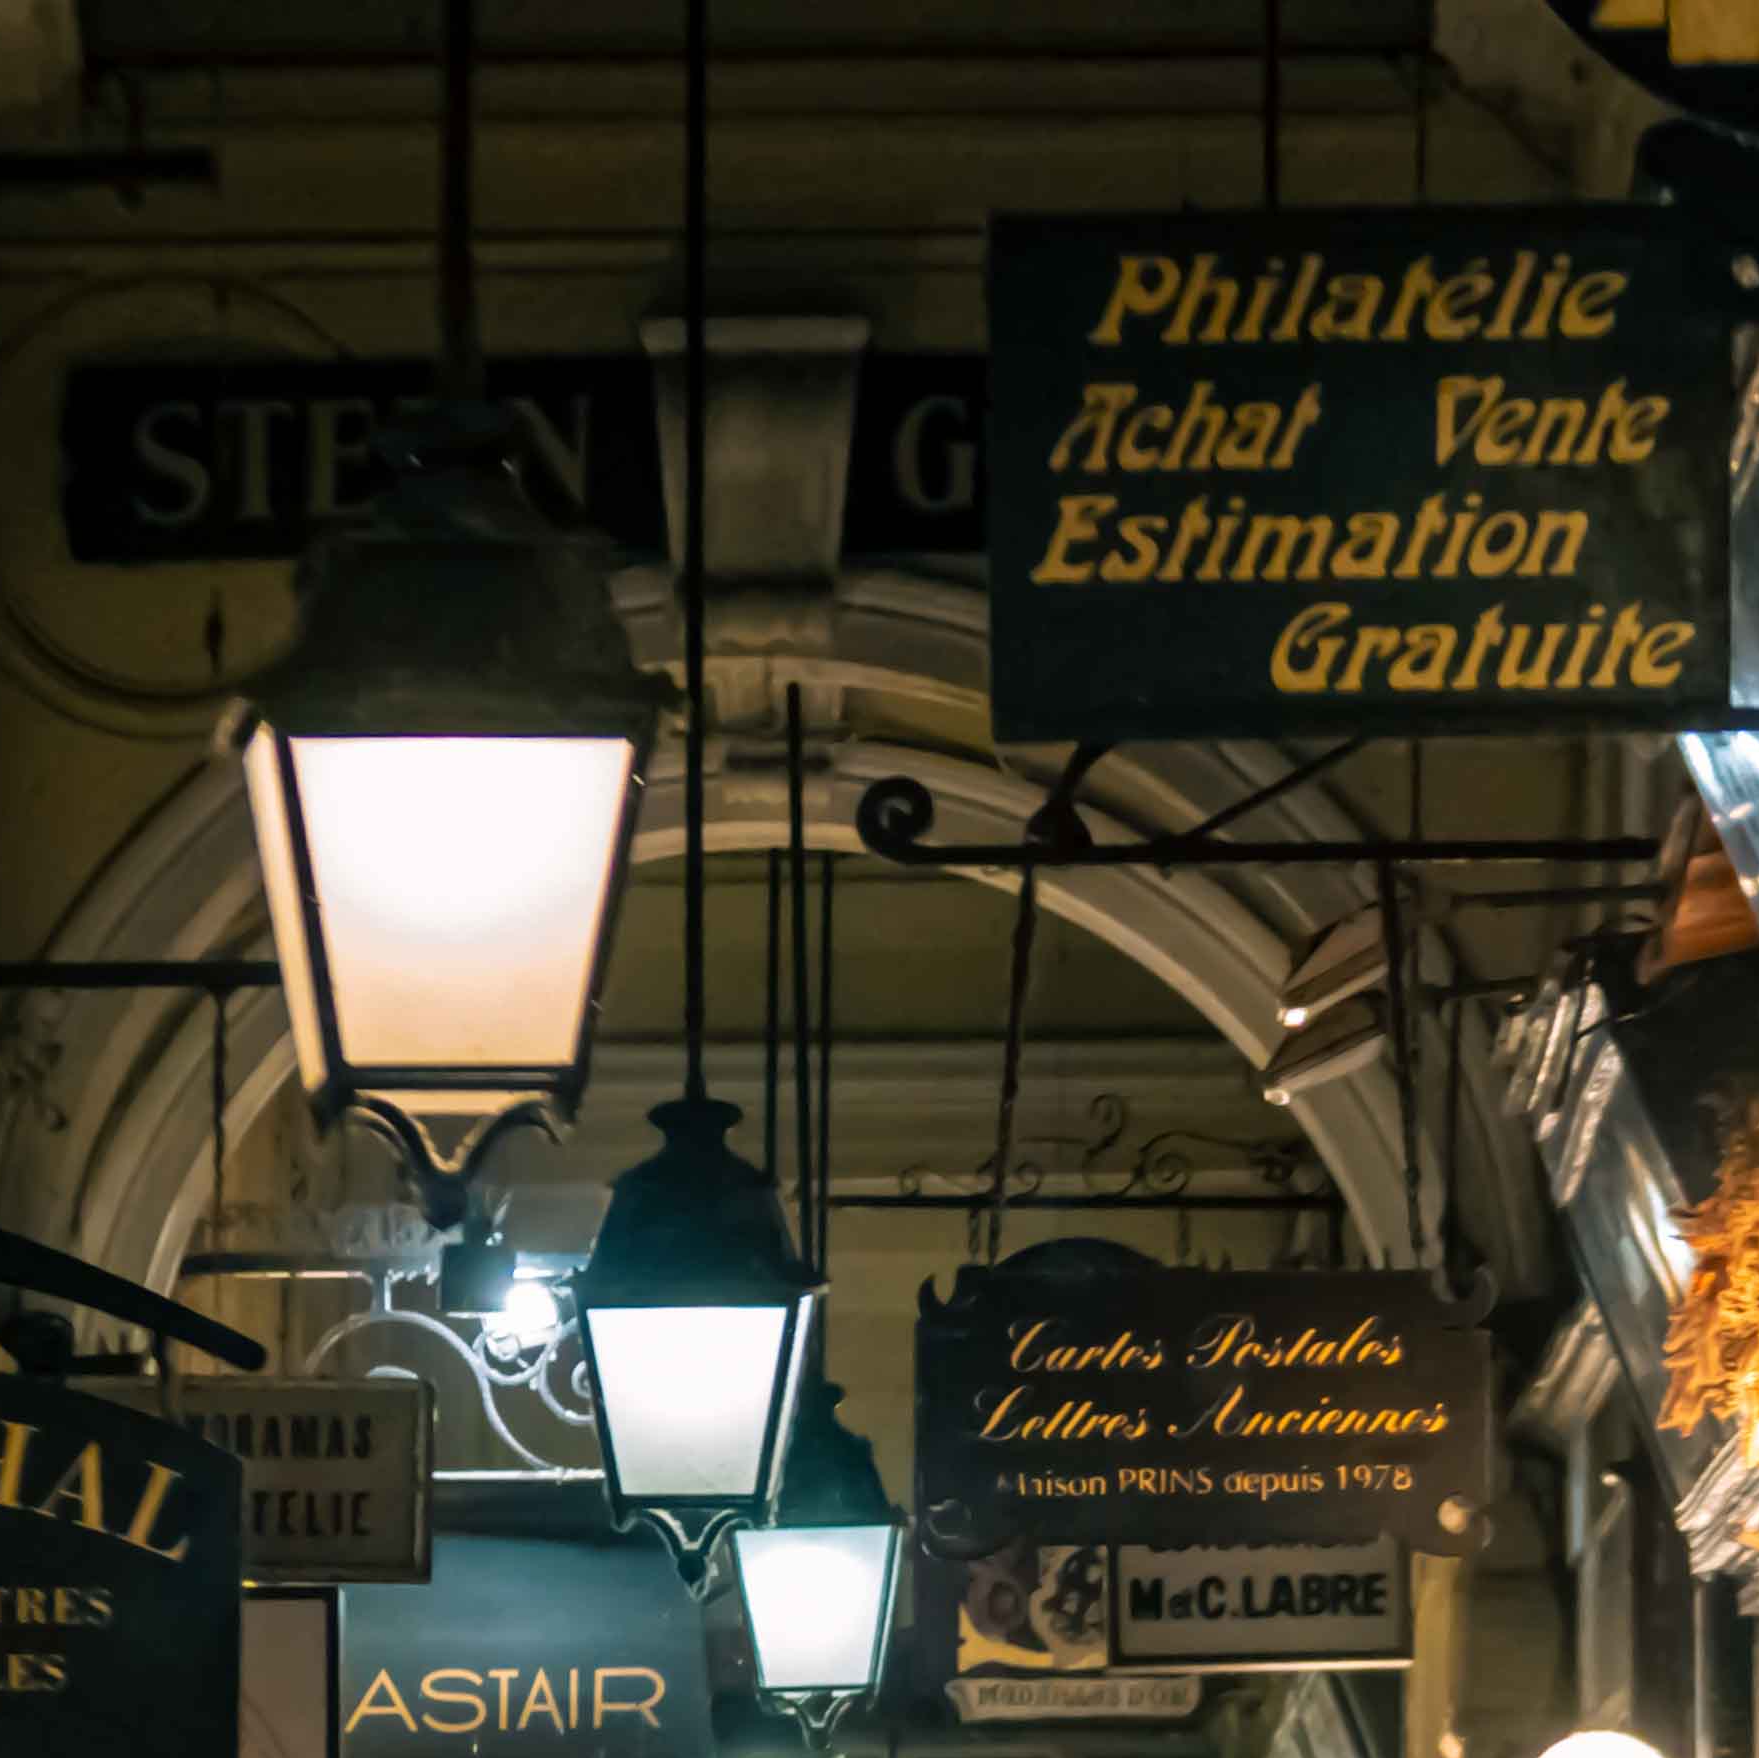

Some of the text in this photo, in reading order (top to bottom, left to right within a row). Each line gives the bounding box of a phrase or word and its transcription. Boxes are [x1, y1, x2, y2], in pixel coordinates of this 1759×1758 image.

[1088, 252, 1628, 343] Philatélie
[131, 394, 592, 523] STEN
[1047, 381, 1322, 472] Achat
[1433, 375, 1670, 466] Vente
[1030, 491, 1589, 584] Estimation
[1269, 602, 1696, 693] Gratuite
[1008, 1313, 1405, 1373] Cartes Postales
[973, 1384, 1450, 1442] Lettres Anciennes
[1118, 1467, 1213, 1495] PRINS
[1224, 1464, 1324, 1501] depuis
[1336, 1464, 1415, 1492] 1978
[344, 1666, 666, 1733] ASTAIR
